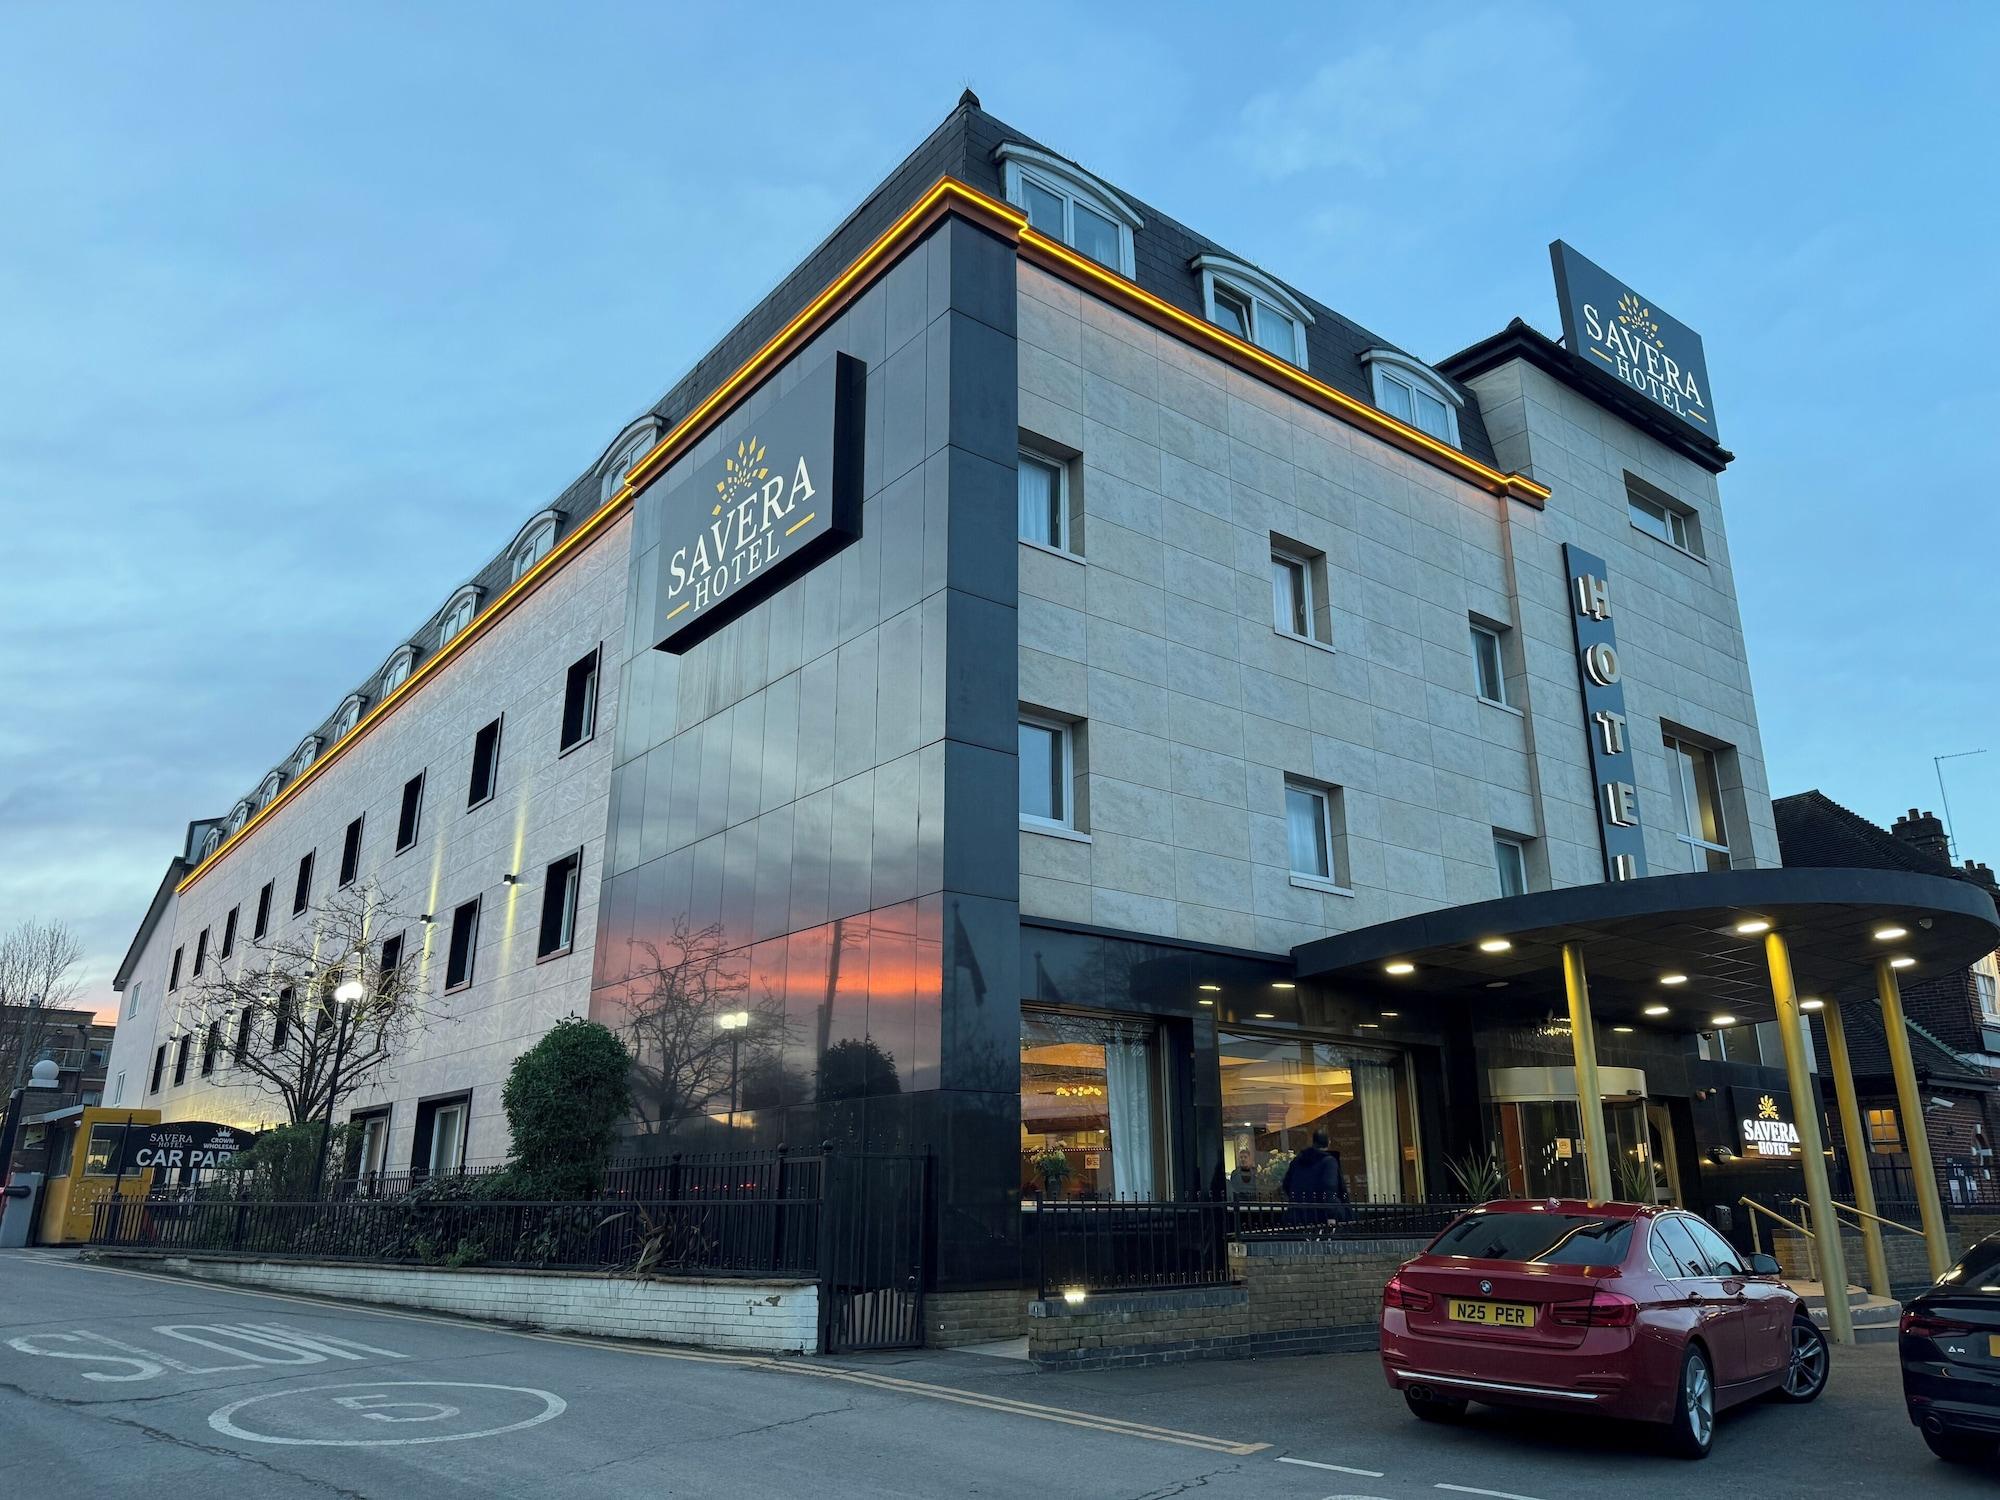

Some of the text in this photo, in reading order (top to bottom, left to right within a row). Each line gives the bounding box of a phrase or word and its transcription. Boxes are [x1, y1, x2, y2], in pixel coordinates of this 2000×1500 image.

[1583, 303, 1705, 408] SAVERA
[1615, 354, 1687, 417] HOTEL
[668, 455, 816, 599] SAVERA
[693, 529, 780, 612] HOTEL
[150, 1132, 193, 1144] SAVERA
[1742, 1119, 1800, 1143] SAVERA
[136, 1148, 232, 1168] CAR PAR
[1757, 1141, 1792, 1156] HOTEL
[1457, 1303, 1525, 1324] N25 PER
[331, 1393, 461, 1423] 5
